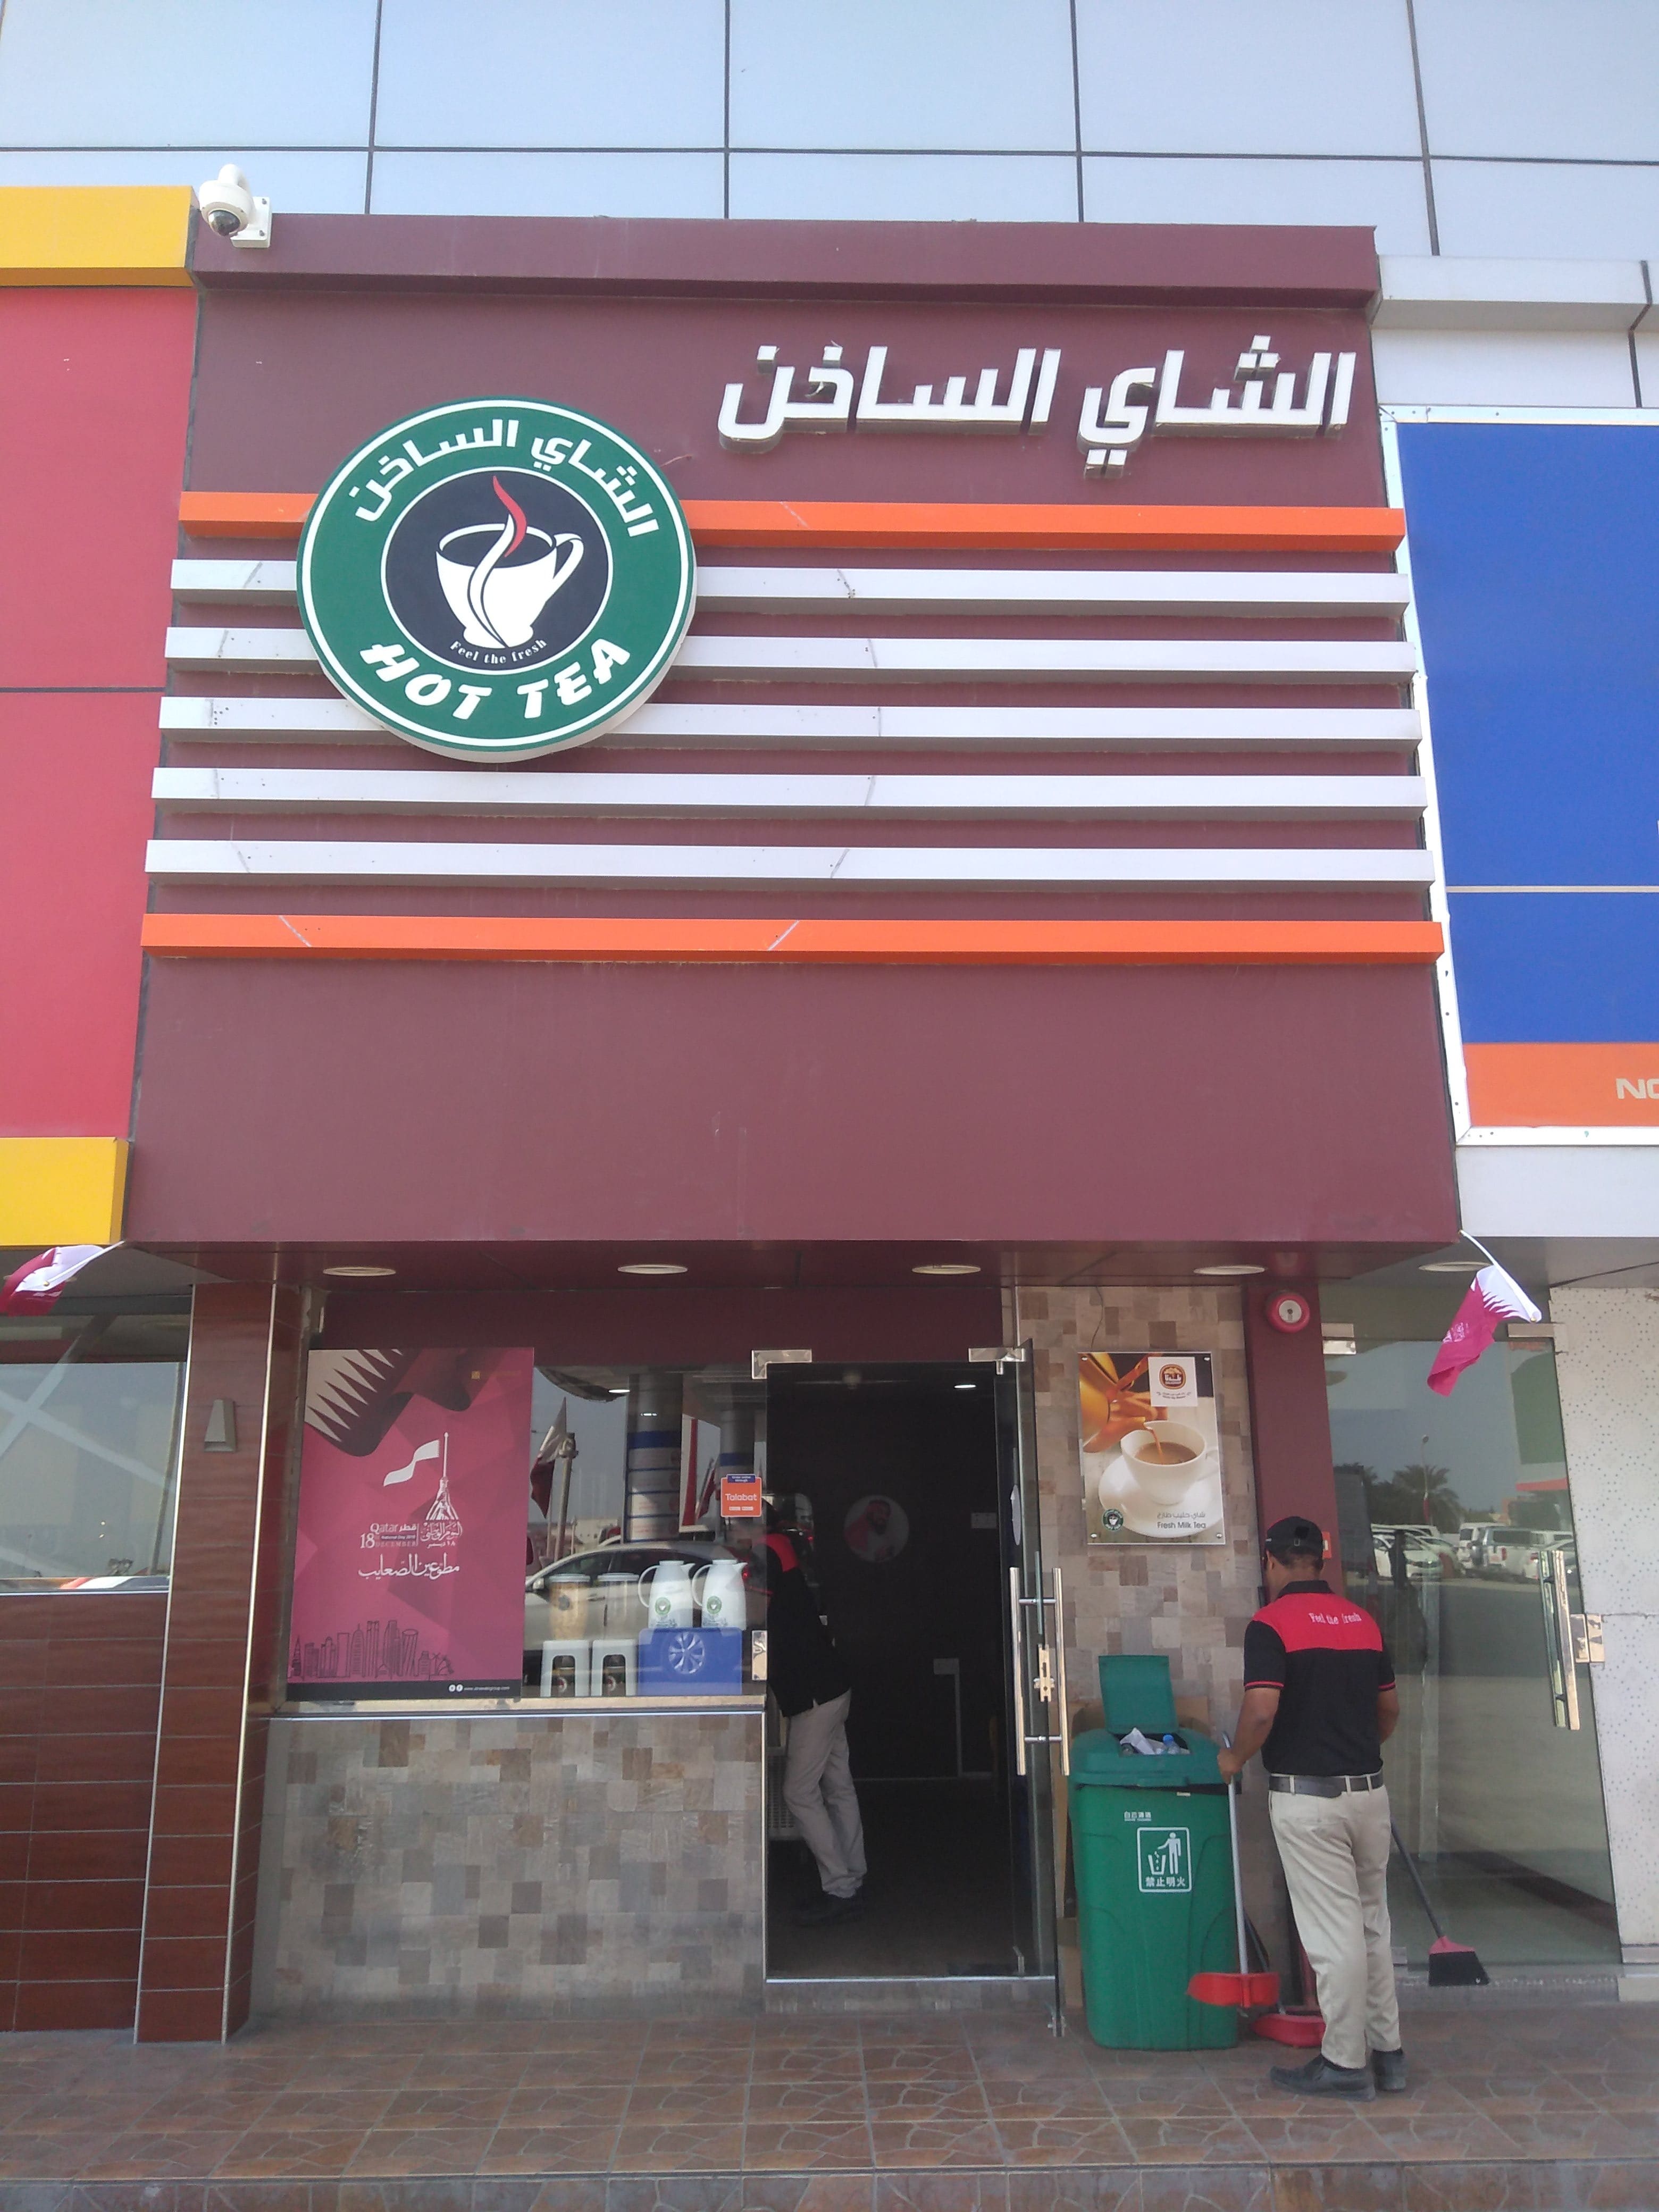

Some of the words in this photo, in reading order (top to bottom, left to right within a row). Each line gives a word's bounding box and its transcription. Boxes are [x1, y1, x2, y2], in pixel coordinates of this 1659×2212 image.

[717, 345, 1061, 451] الساخن
[1078, 334, 1356, 473] الشاي
[348, 418, 519, 522] الساخن
[531, 437, 659, 537] الشاي
[359, 643, 492, 720] HOT
[517, 639, 631, 719] TEA
[450, 641, 479, 661] Feel
[484, 653, 506, 664] the
[511, 640, 547, 661] fresh
[360, 1533, 375, 1548] 18
[370, 1523, 398, 1535] Qatar
[399, 1523, 417, 1532] قطر
